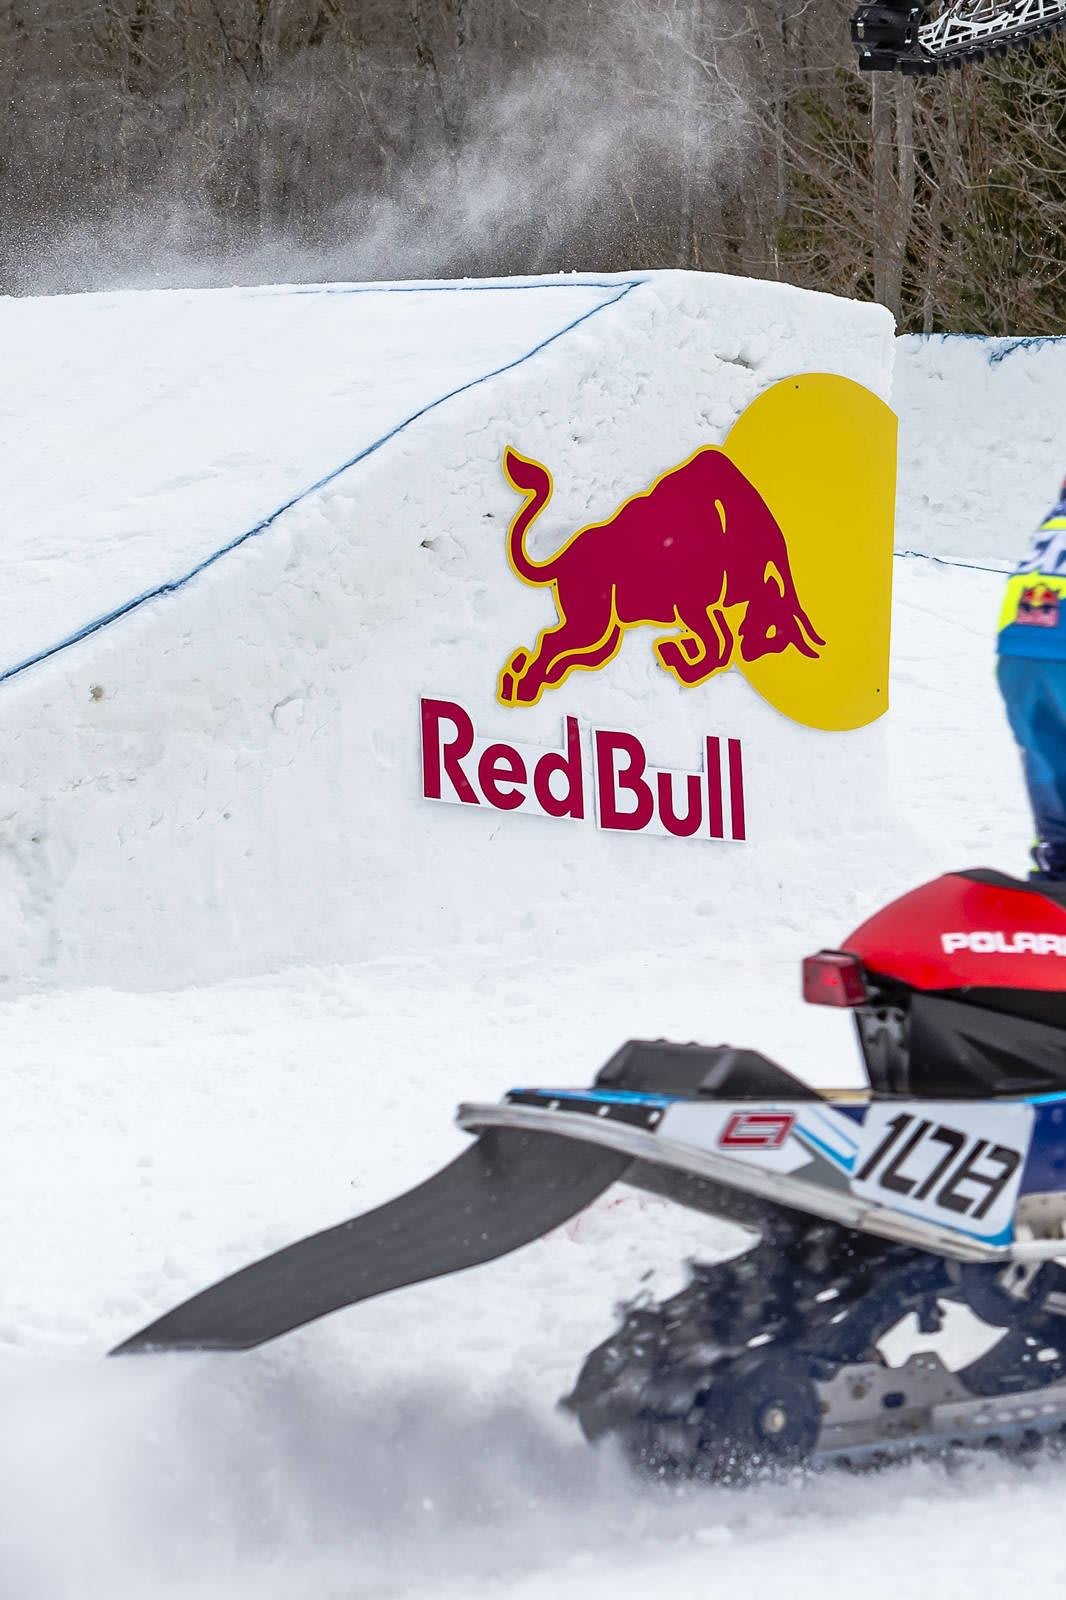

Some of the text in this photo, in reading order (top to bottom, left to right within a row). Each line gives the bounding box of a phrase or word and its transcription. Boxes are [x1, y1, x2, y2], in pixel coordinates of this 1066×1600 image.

[420, 697, 747, 841] Red Bull
[854, 1112, 1022, 1220] 108
